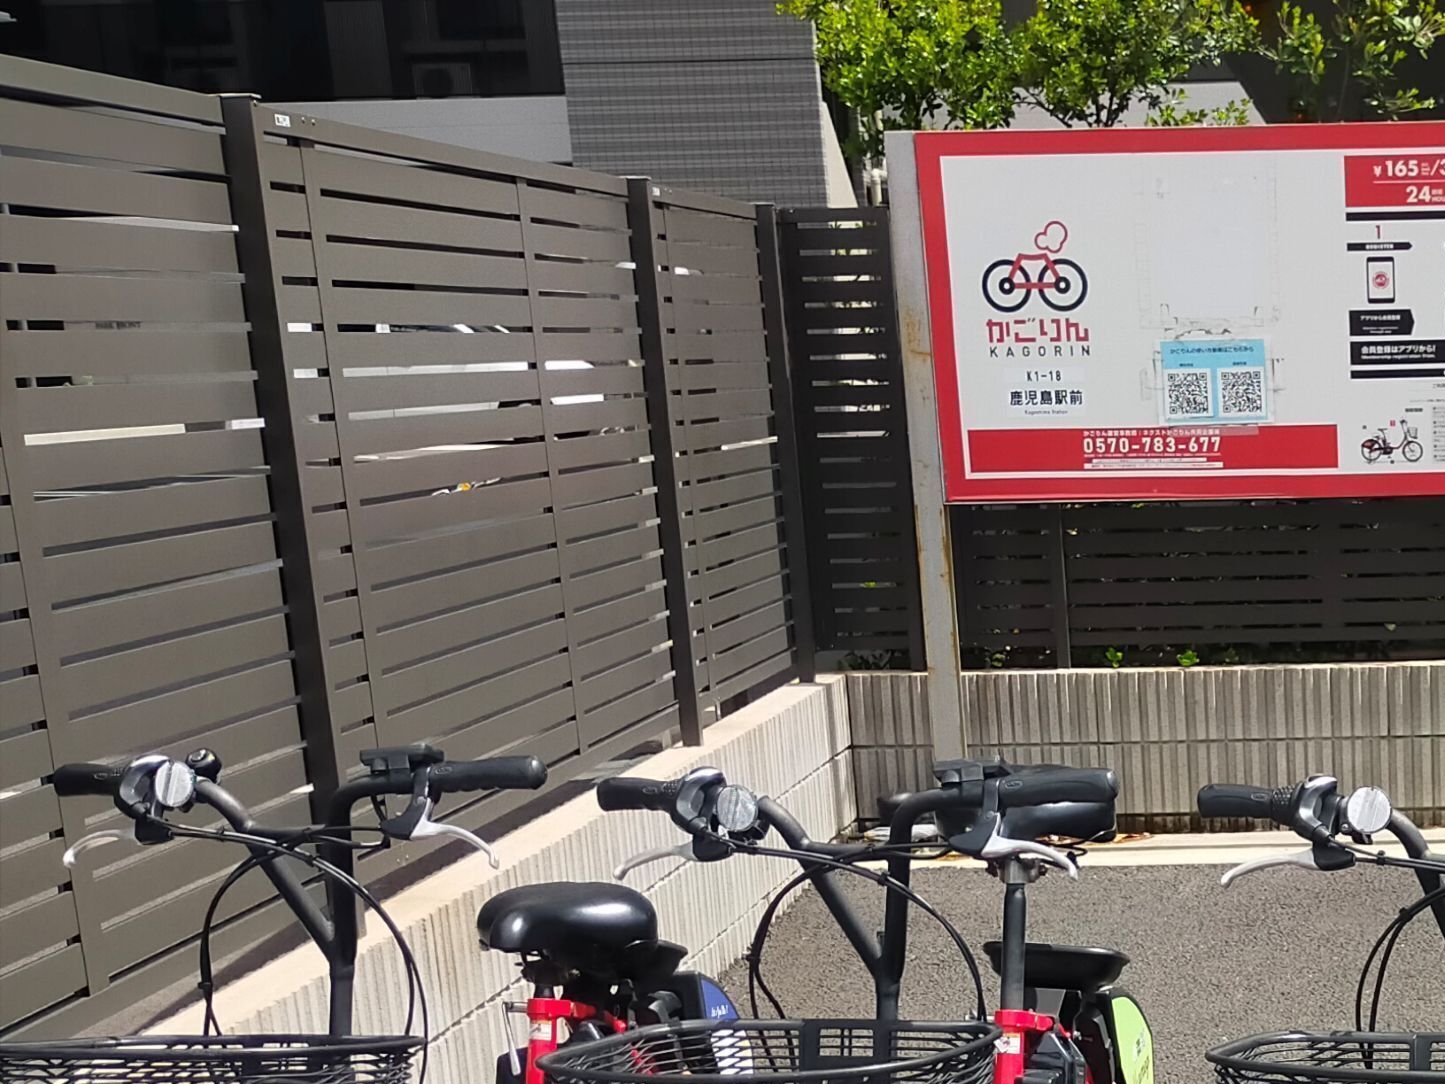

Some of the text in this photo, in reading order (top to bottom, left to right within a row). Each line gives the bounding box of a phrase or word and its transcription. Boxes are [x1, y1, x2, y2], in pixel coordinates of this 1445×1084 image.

[1406, 186, 1431, 203] 24
[1375, 225, 1381, 239] 1
[986, 318, 1089, 343] かごりん
[990, 345, 1090, 358] KAGORIN
[1026, 370, 1061, 381] K1-18
[1010, 390, 1083, 406] 鹿児島駅前
[1083, 437, 1221, 453] 0570-783-677
